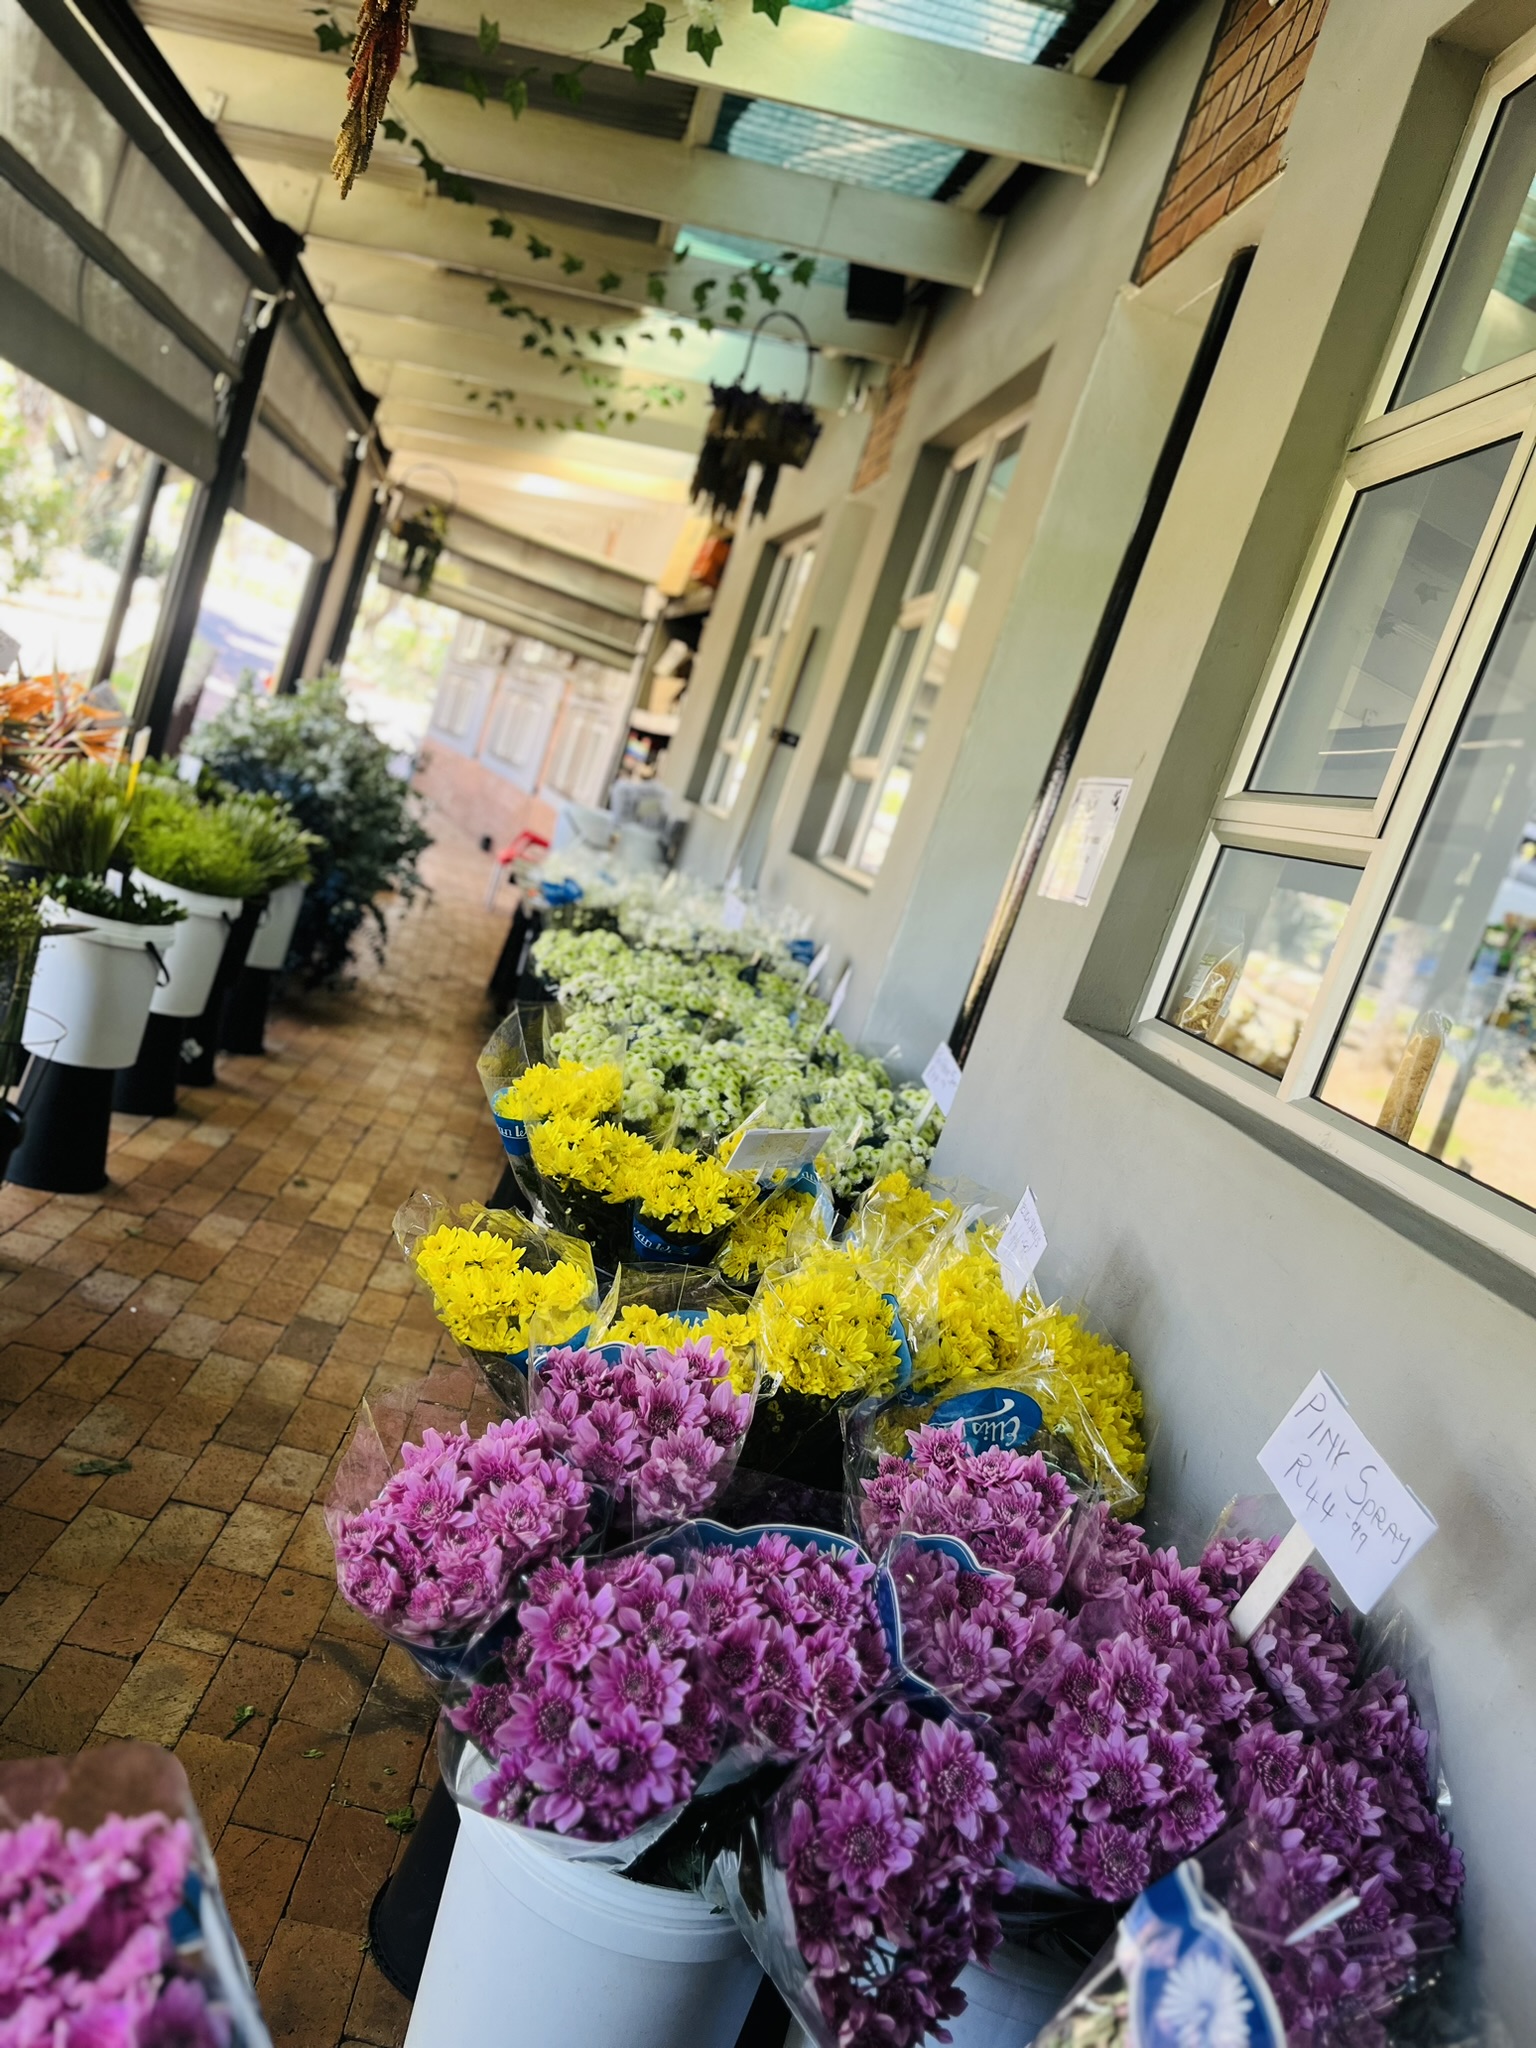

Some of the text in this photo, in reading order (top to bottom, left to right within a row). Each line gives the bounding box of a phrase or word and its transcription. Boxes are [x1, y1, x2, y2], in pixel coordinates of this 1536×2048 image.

[972, 1416, 1021, 1447] Ellis
[1294, 1392, 1411, 1565] PINK SPRAY
